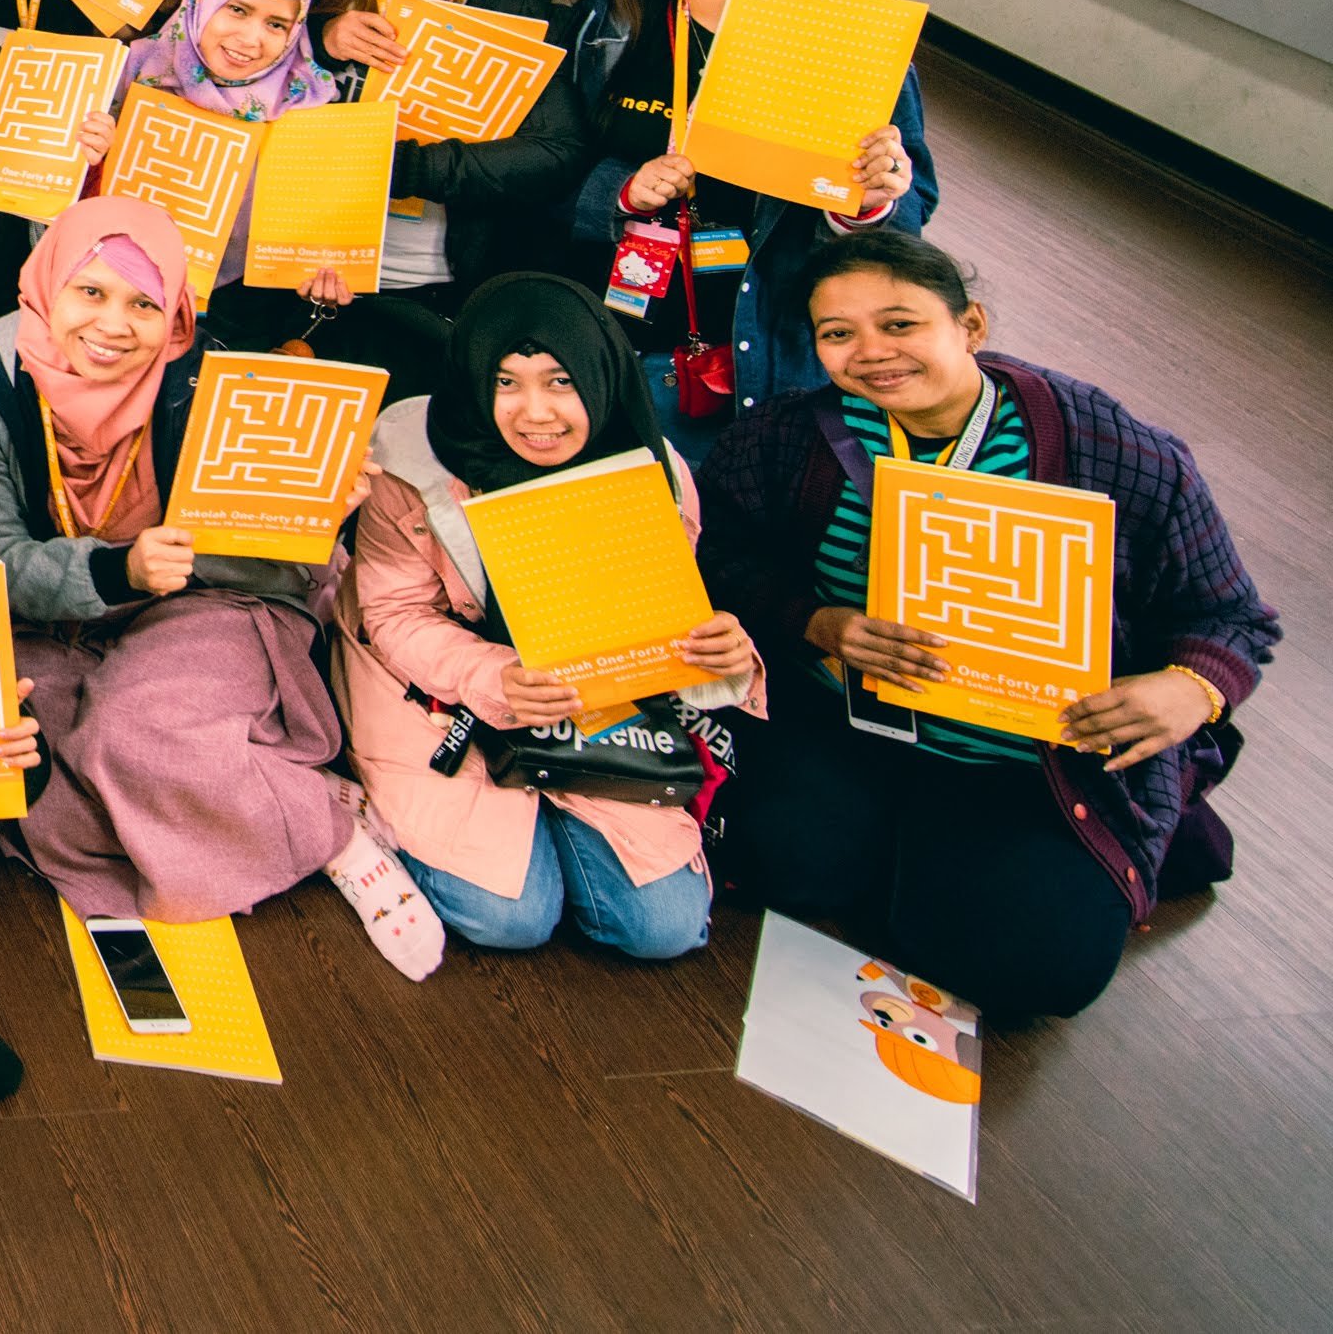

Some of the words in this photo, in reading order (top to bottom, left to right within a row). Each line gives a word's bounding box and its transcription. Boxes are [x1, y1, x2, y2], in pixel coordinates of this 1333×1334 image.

[2, 167, 43, 182] One-Forty
[254, 245, 295, 255] Sekolah
[297, 247, 347, 259] One-Forty
[690, 246, 725, 256] unarti
[180, 509, 227, 519] Sekolah
[230, 510, 291, 525] One-Forty
[294, 516, 332, 529] 作業本
[550, 660, 594, 678] kolah
[596, 644, 666, 669] One-Forty
[957, 665, 1040, 693] One-Forty
[1044, 684, 1093, 704] 作業
[444, 708, 475, 753] FISH
